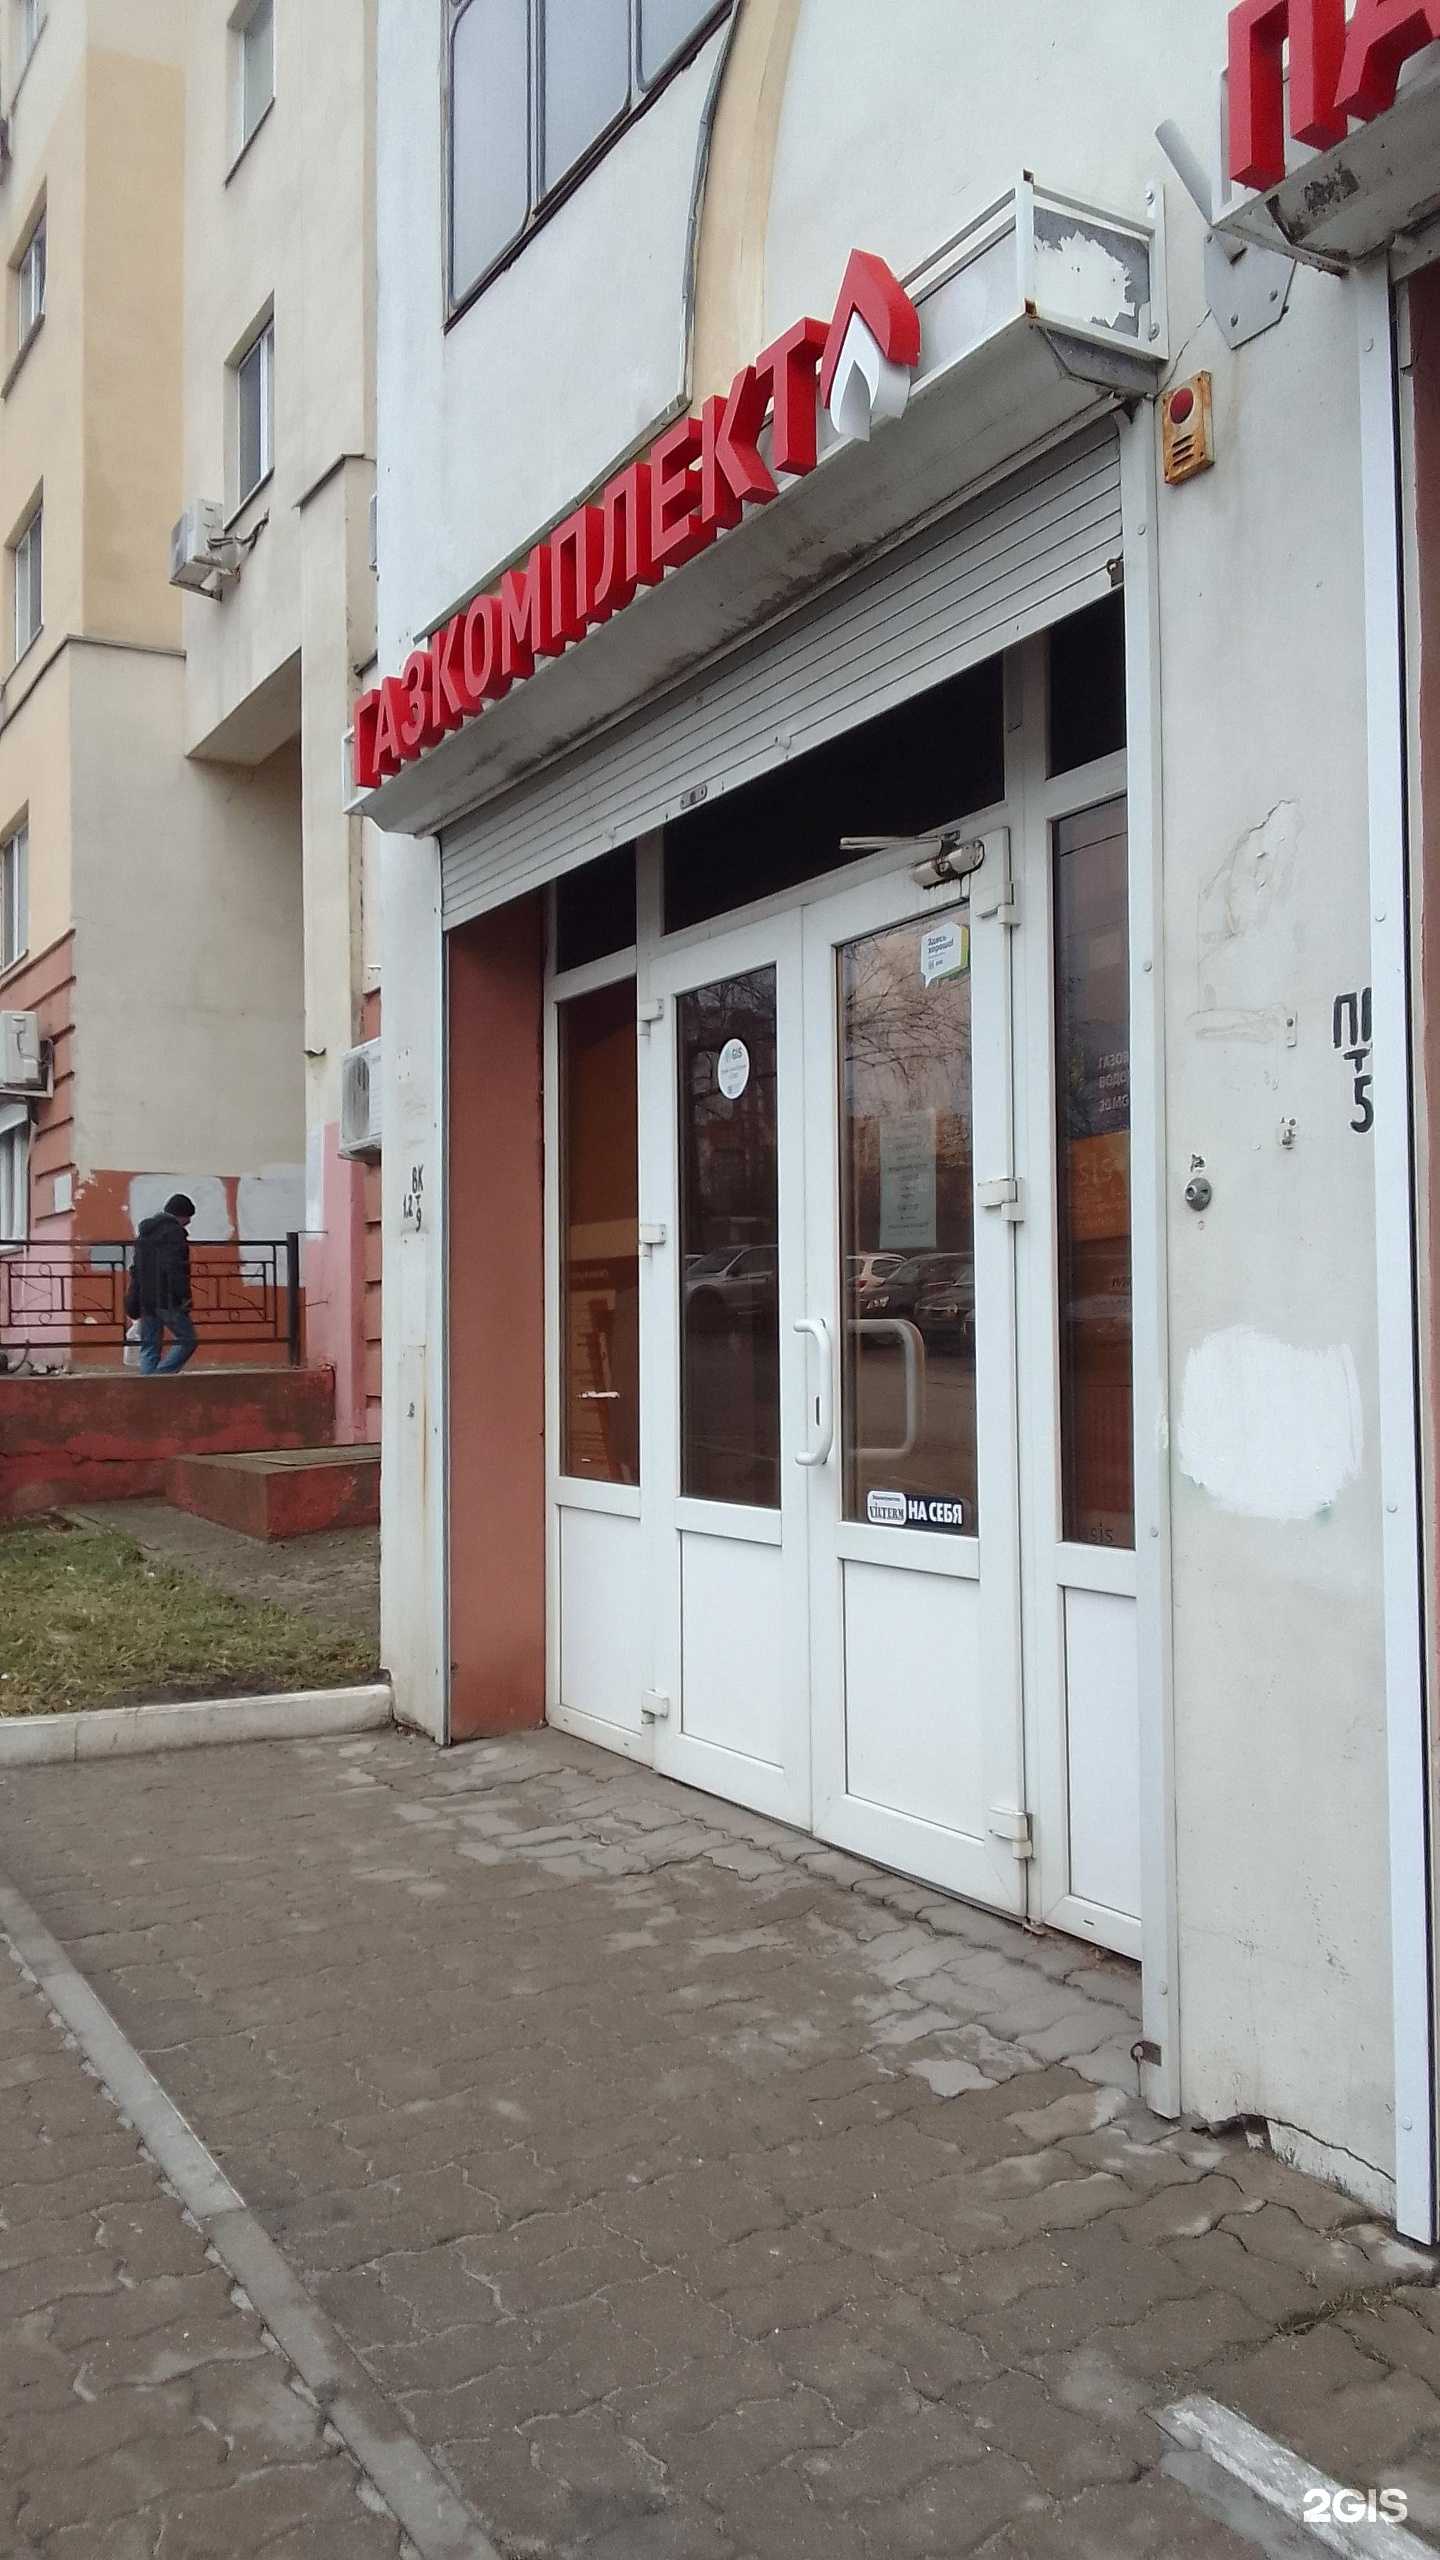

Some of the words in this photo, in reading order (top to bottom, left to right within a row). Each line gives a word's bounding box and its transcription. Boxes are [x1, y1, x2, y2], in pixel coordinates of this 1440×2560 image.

[354, 317, 832, 788] ГАЗКОМПЛЕКТ
[1350, 1074, 1374, 1133] 5
[908, 1500, 928, 1521] НА
[929, 1502, 962, 1525] СЕБЯ
